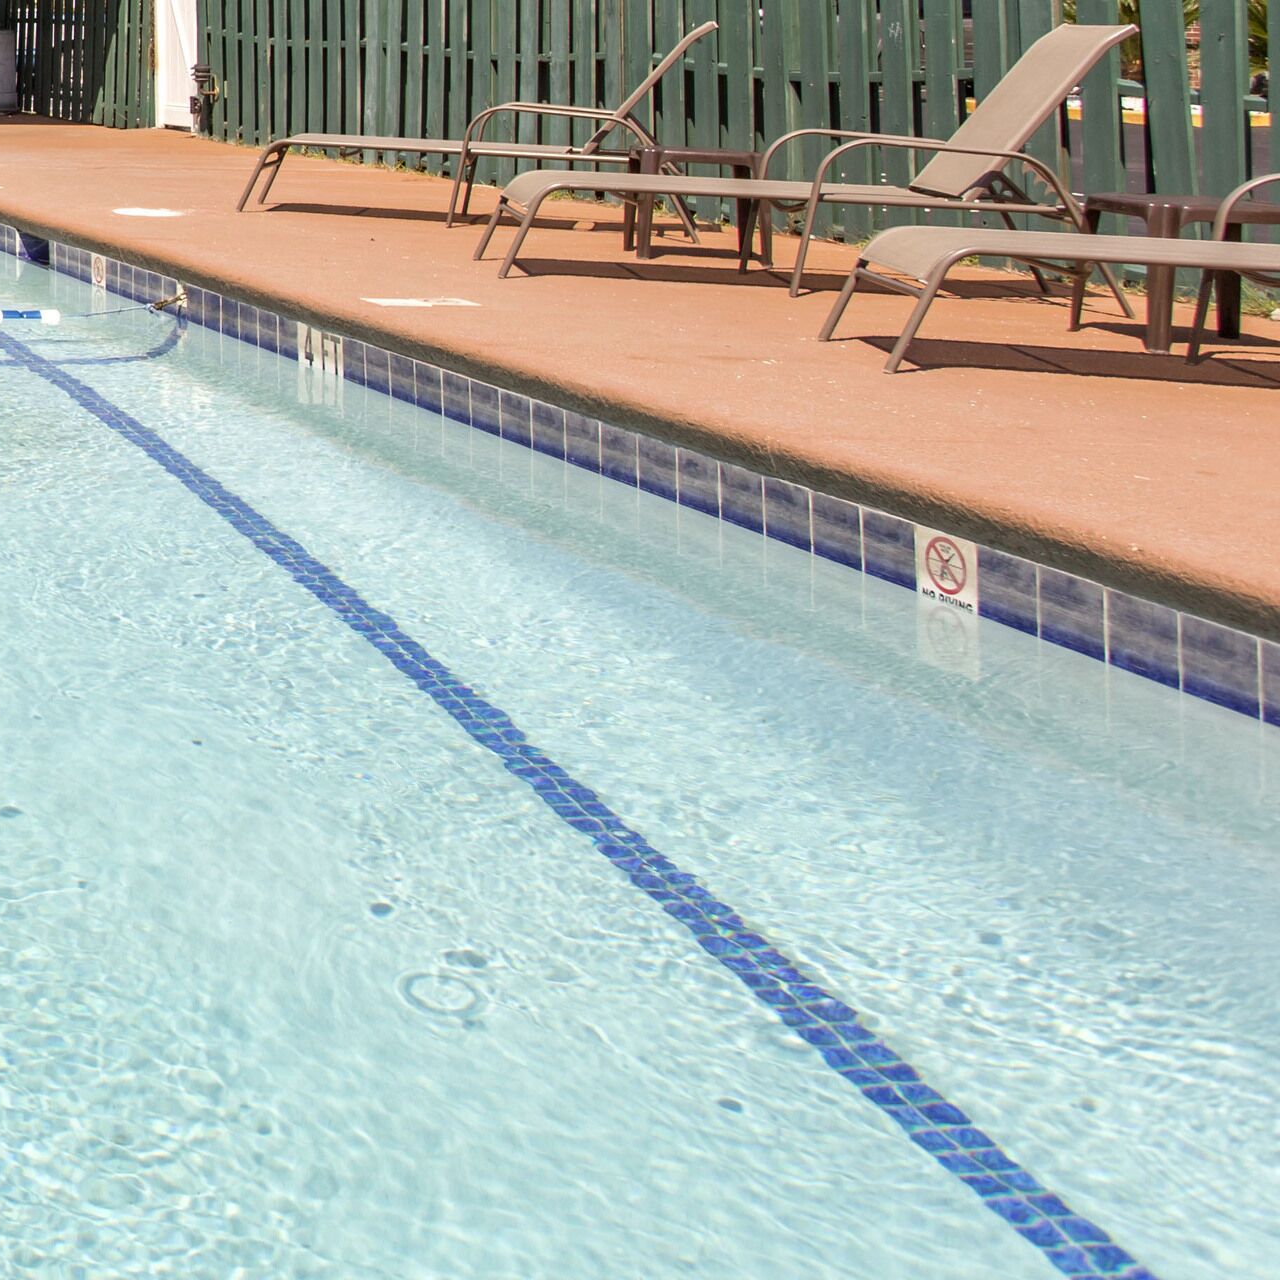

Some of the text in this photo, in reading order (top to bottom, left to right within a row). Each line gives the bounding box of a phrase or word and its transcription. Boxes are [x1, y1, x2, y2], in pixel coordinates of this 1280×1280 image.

[304, 325, 341, 376] 4 FT
[922, 587, 975, 613] NO DIVING
